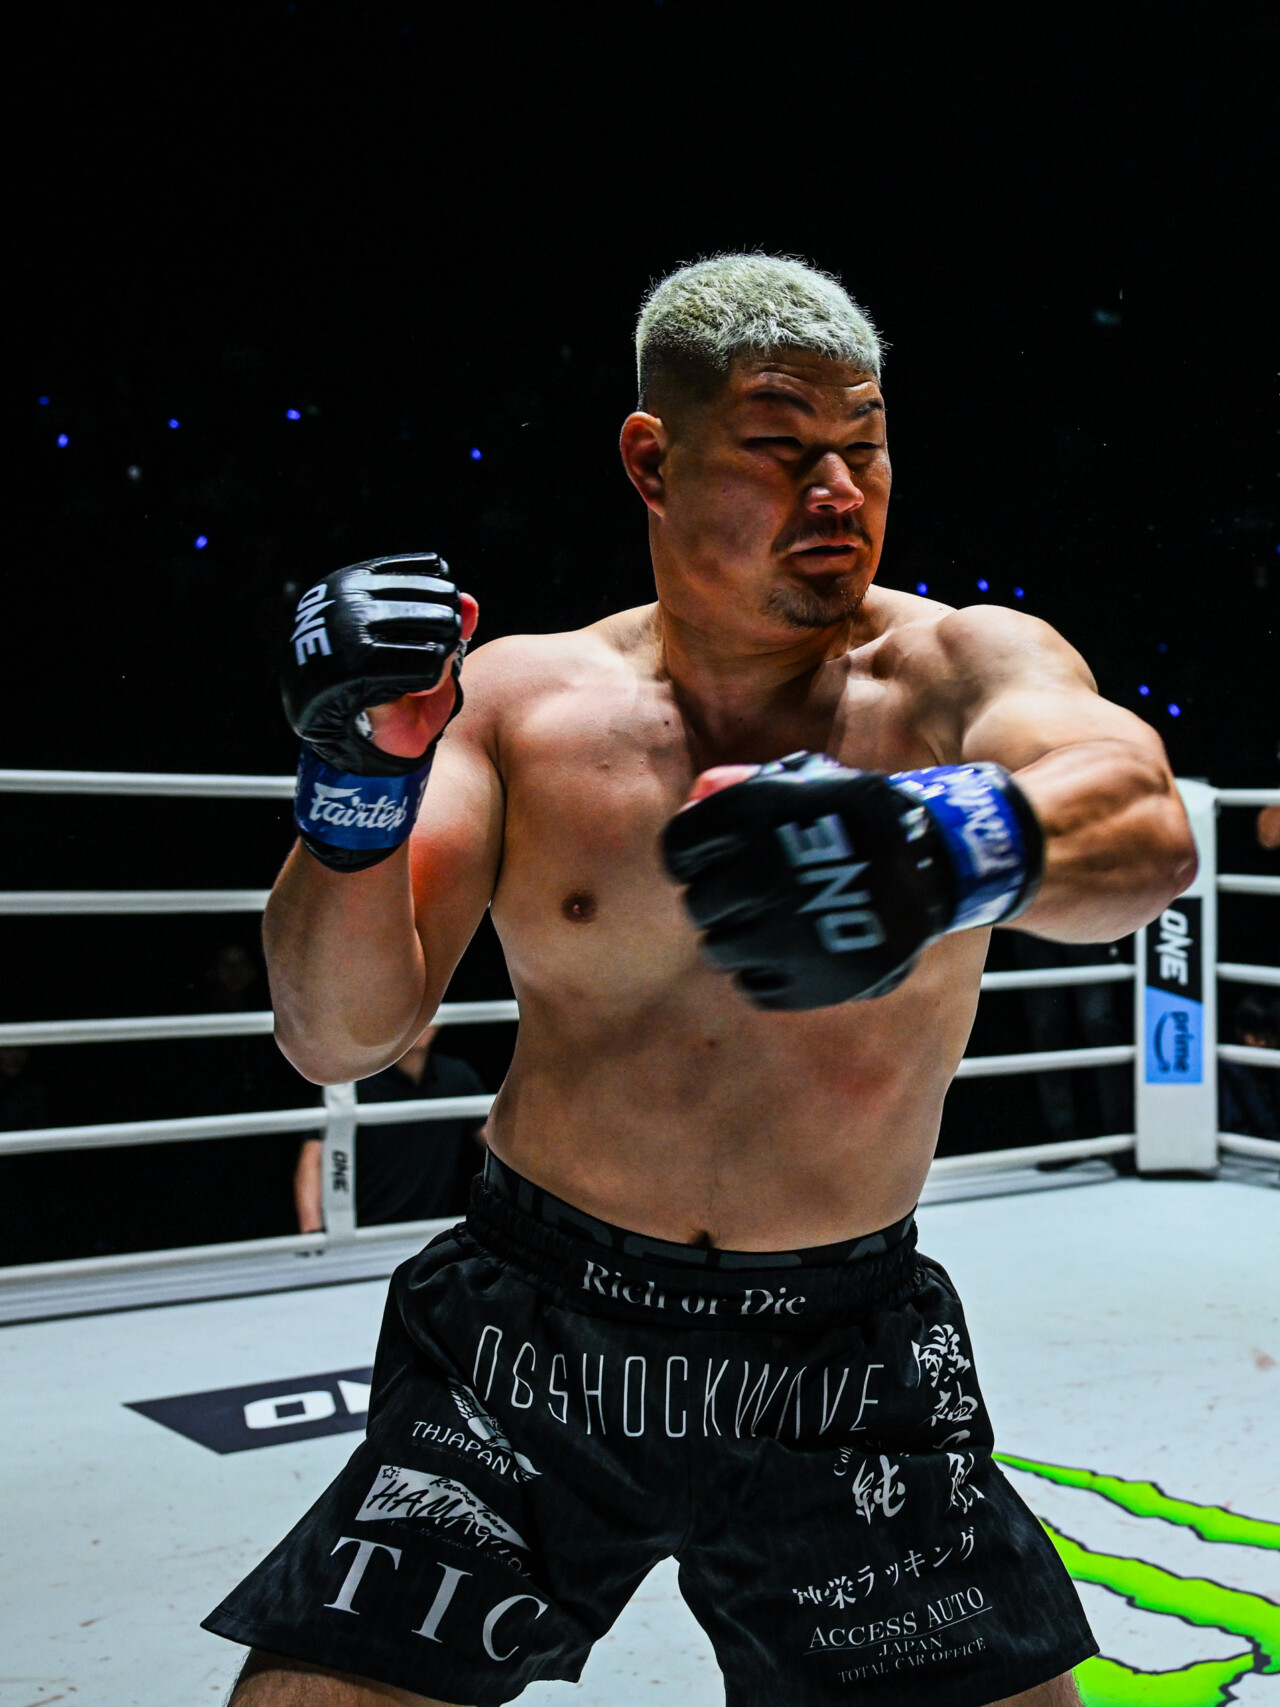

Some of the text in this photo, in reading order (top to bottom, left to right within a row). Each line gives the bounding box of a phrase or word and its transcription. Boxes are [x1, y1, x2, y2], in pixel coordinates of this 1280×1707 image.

[289, 583, 336, 666] ONE
[308, 782, 408, 832] Fairtex
[775, 814, 887, 953] ONE
[1155, 908, 1193, 985] ONE
[1172, 1011, 1193, 1073] prime
[331, 1150, 349, 1193] ONE
[582, 1259, 806, 1315] Rich or Die
[411, 1421, 512, 1475] THJAPAN
[323, 1536, 549, 1661] TIC
[809, 1586, 985, 1648] ACCESS AUTO
[837, 1637, 987, 1683] TOTAL CAR OFFICE
[878, 1633, 943, 1656] JAPAN
